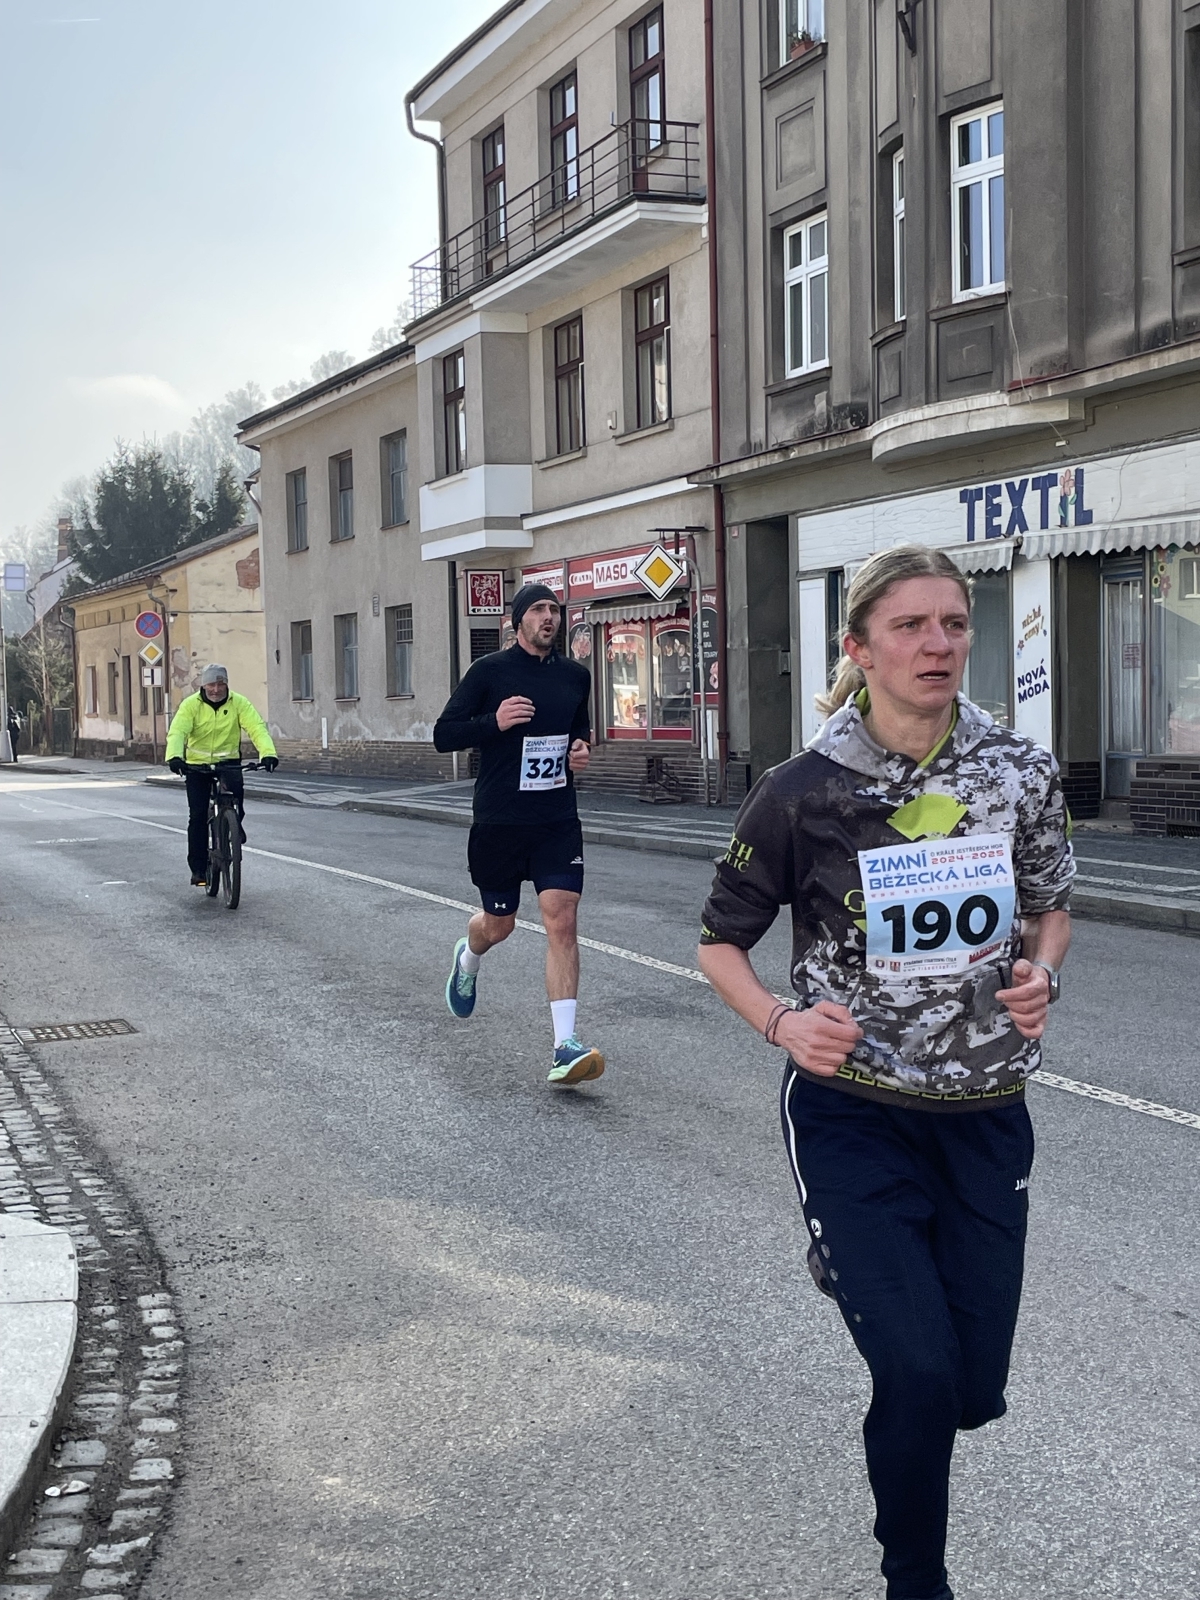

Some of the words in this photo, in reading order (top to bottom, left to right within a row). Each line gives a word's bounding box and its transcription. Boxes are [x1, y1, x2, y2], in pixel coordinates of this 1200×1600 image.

[959, 467, 1094, 542] TEXTIL
[595, 562, 628, 584] MASO
[1017, 658, 1047, 688] NOVÁ
[525, 757, 564, 779] 325
[866, 849, 927, 874] ZIMNÍ
[931, 849, 1005, 865] 2024-2025
[869, 866, 959, 890] BĚŽECKÁ
[964, 863, 1008, 879] LIGA
[881, 894, 999, 953] 190
